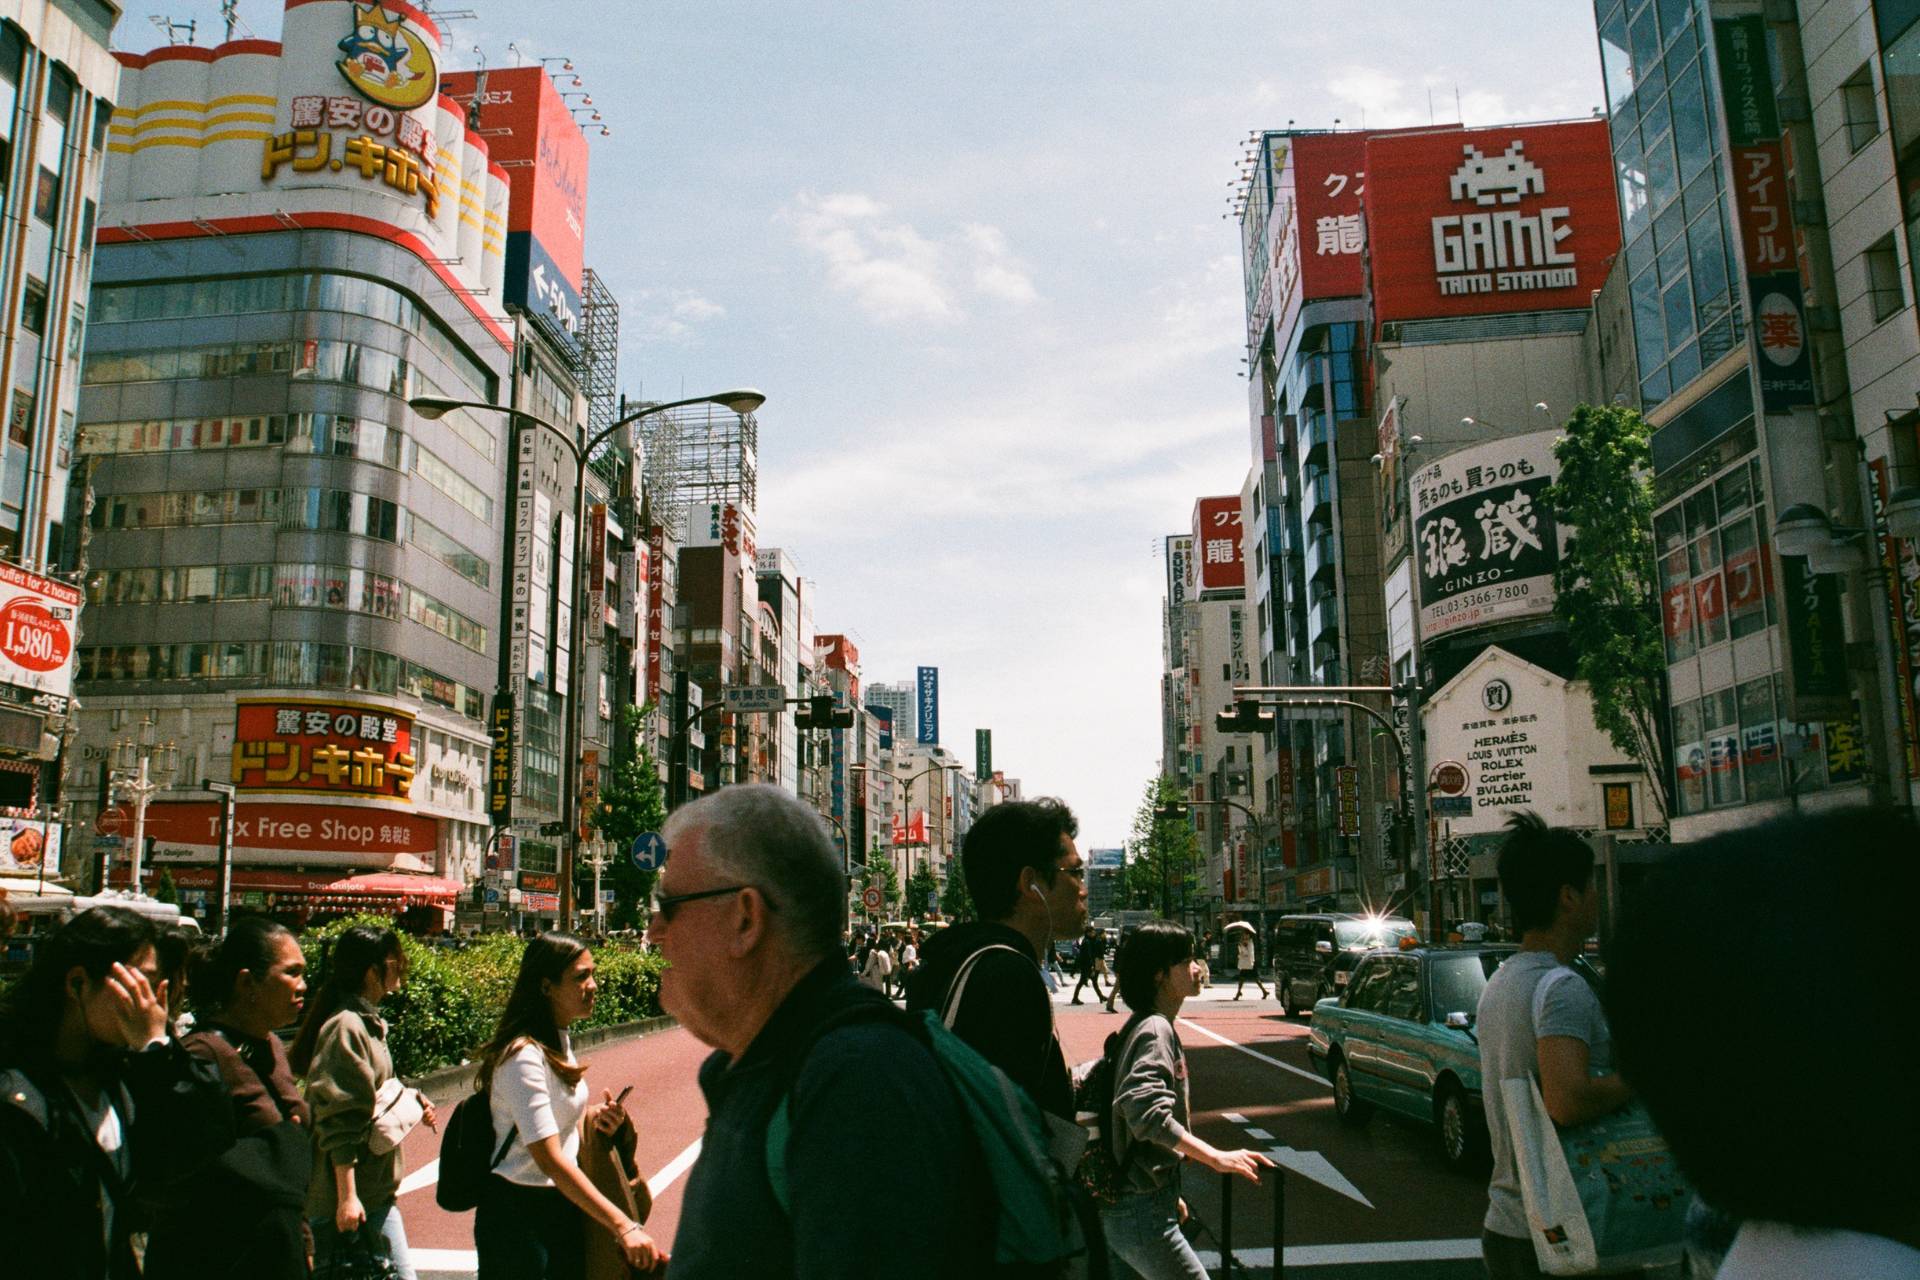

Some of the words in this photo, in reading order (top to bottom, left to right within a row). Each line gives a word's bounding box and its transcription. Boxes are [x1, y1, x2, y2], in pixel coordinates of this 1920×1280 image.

[1743, 151, 1787, 263] アイフル
[1316, 214, 1364, 257] 龍
[1431, 206, 1576, 273] GAME
[1437, 272, 1492, 296] TAITO
[1497, 267, 1577, 292] STATION
[549, 277, 578, 338] 50m
[1759, 312, 1801, 350] 薬
[647, 532, 663, 593] カラオケ
[0, 566, 26, 586] uffet
[27, 574, 42, 591] for
[42, 580, 51, 594] 2
[51, 583, 78, 604] hours
[4, 620, 53, 662] 1,980
[645, 609, 662, 664] パセラ
[1486, 684, 1504, 707] 質
[275, 708, 398, 743] 驚安の殿堂
[1467, 749, 1493, 762] LOUIS
[1496, 744, 1538, 757] VUITTON
[1481, 758, 1524, 772] ROLEX
[1477, 782, 1533, 797] BVLGARI
[1480, 771, 1527, 784] Cartier
[1478, 794, 1532, 807] CHANEL
[208, 816, 250, 839] Tx
[258, 816, 312, 839] Free
[320, 818, 375, 844] Shop
[380, 826, 411, 846] 免税店
[308, 881, 328, 890] Don
[330, 881, 366, 892] Quijote
